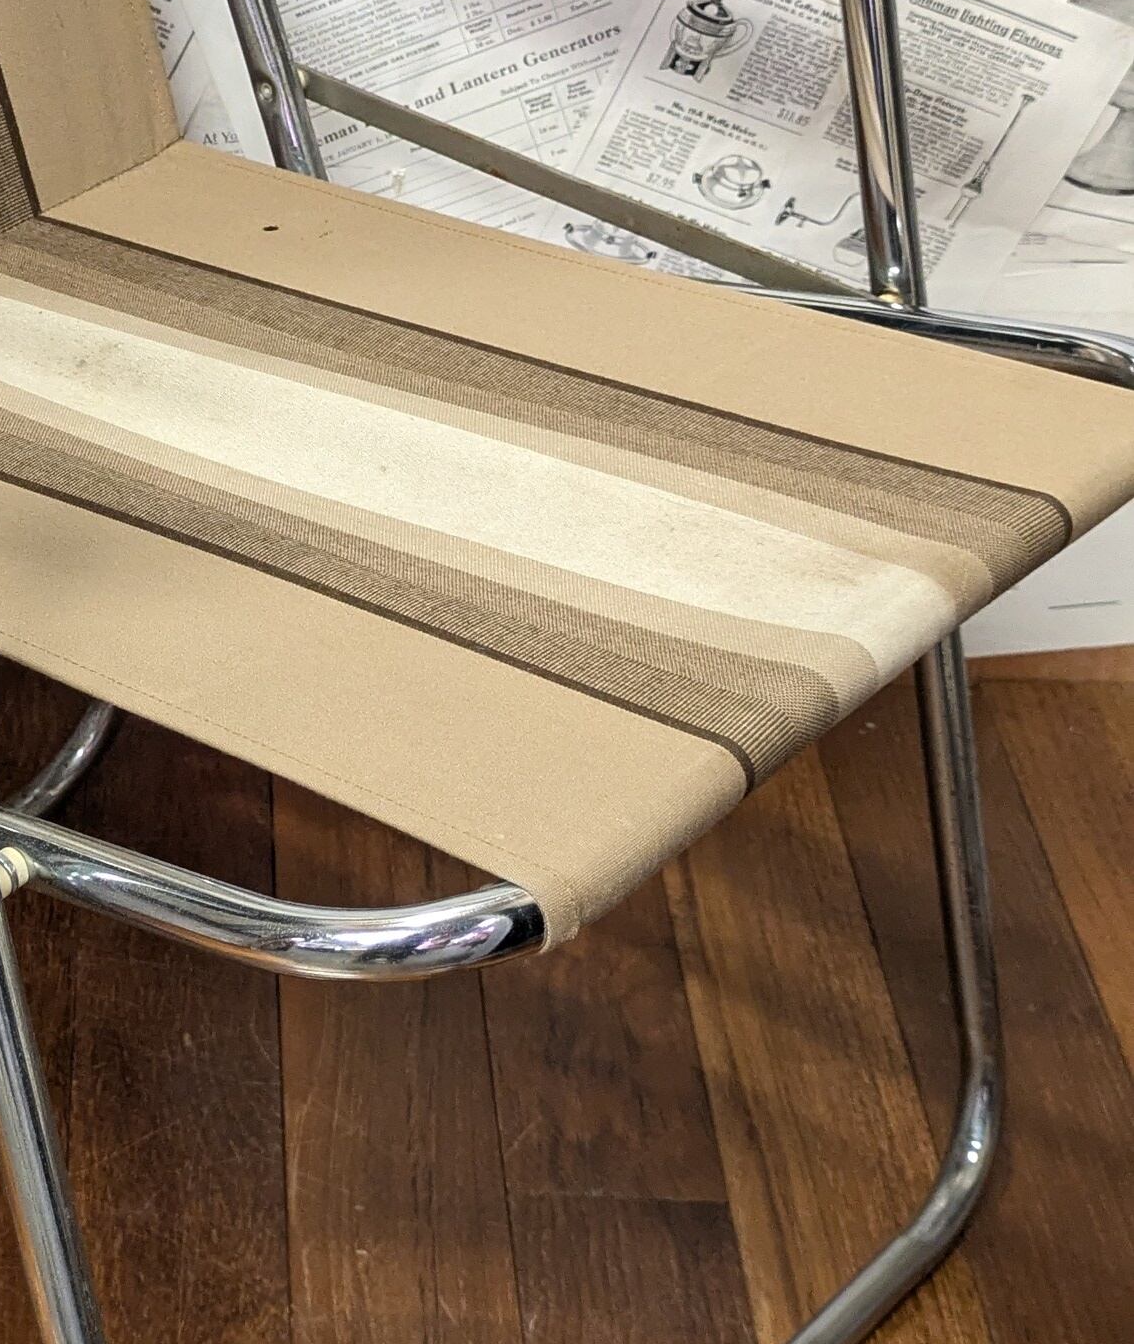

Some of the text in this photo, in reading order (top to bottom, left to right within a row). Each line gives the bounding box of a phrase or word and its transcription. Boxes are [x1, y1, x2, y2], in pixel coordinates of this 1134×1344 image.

[1008, 28, 1063, 59] Fixtures
[414, 25, 622, 109] and Lantern Generators
[707, 115, 729, 128] Waffle
[731, 124, 756, 137] Maker
